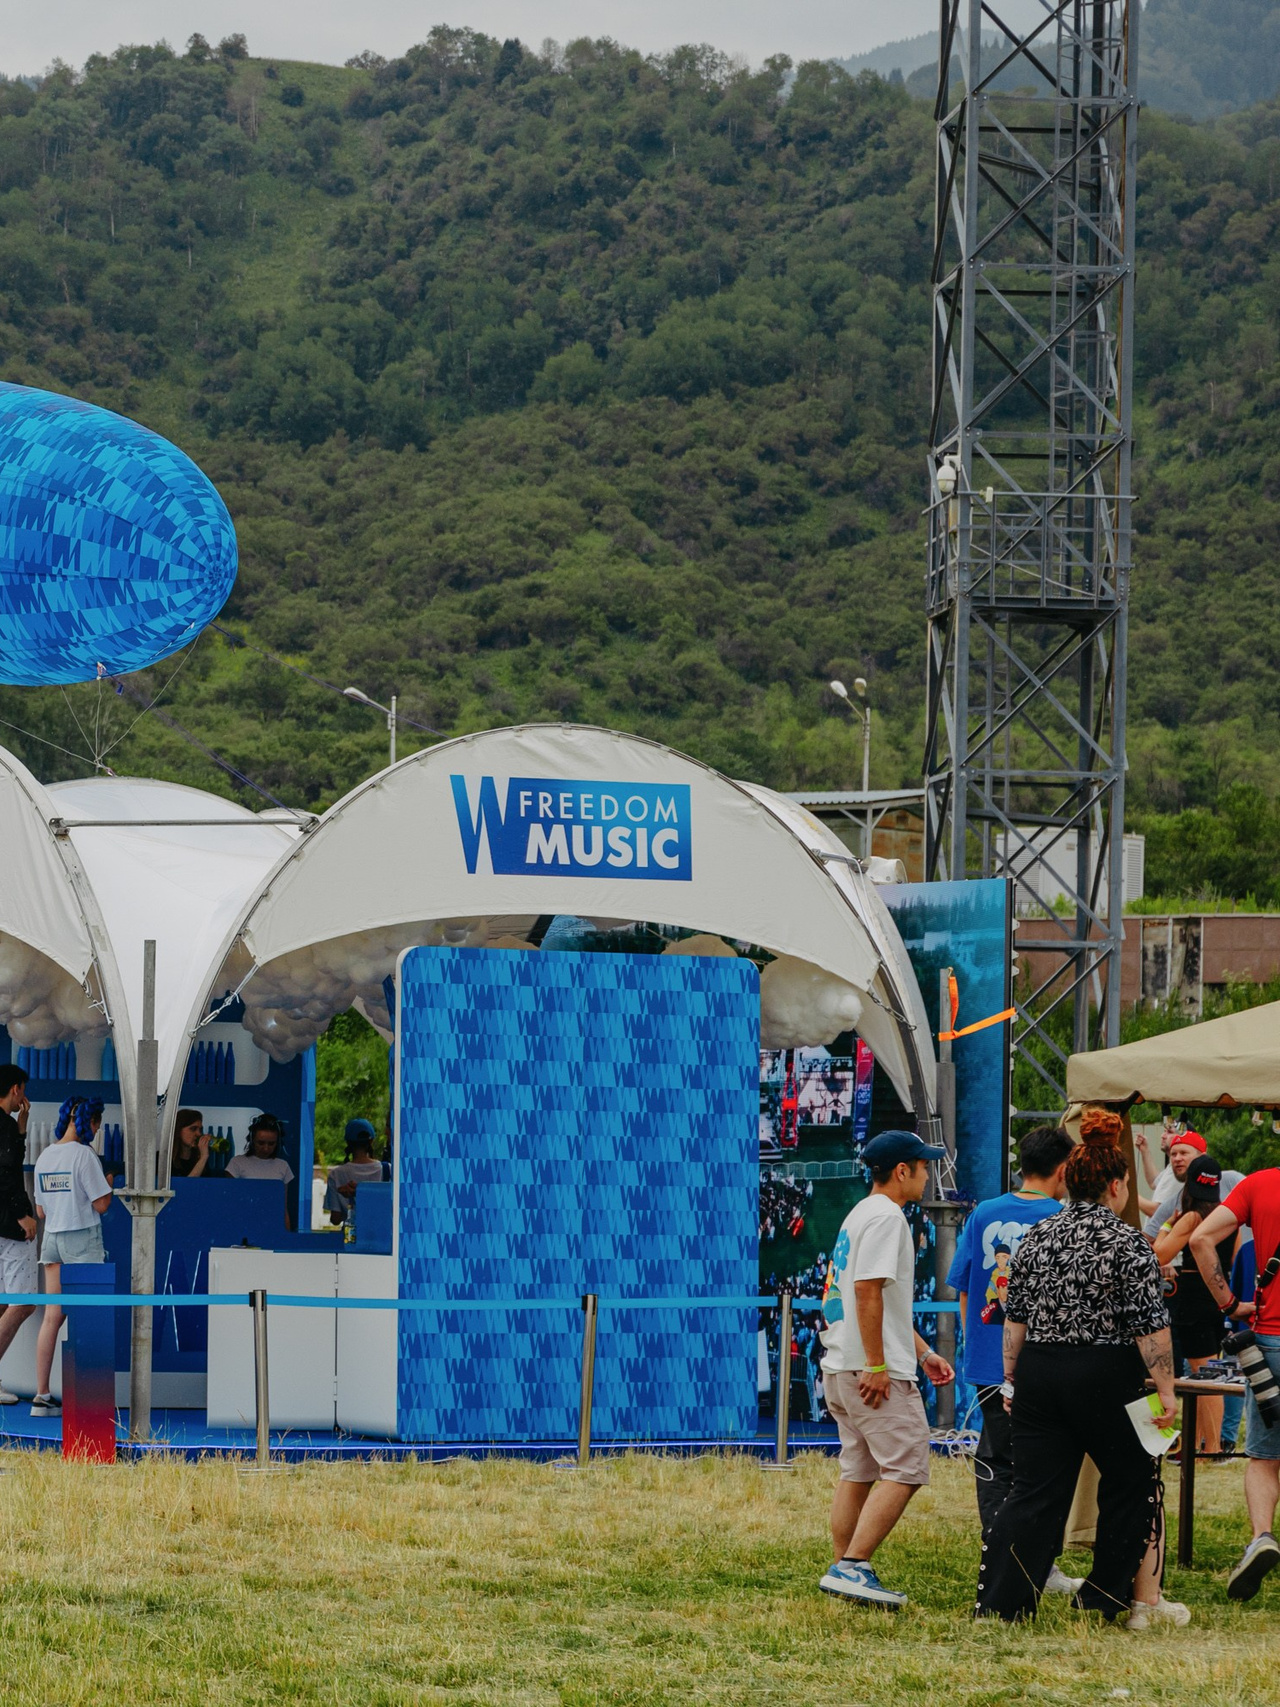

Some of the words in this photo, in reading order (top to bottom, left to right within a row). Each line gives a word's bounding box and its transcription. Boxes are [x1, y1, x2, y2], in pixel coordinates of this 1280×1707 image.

[520, 790, 678, 823] FREEDOM
[525, 823, 680, 869] MUSIC
[50, 1181, 70, 1189] MUSIC
